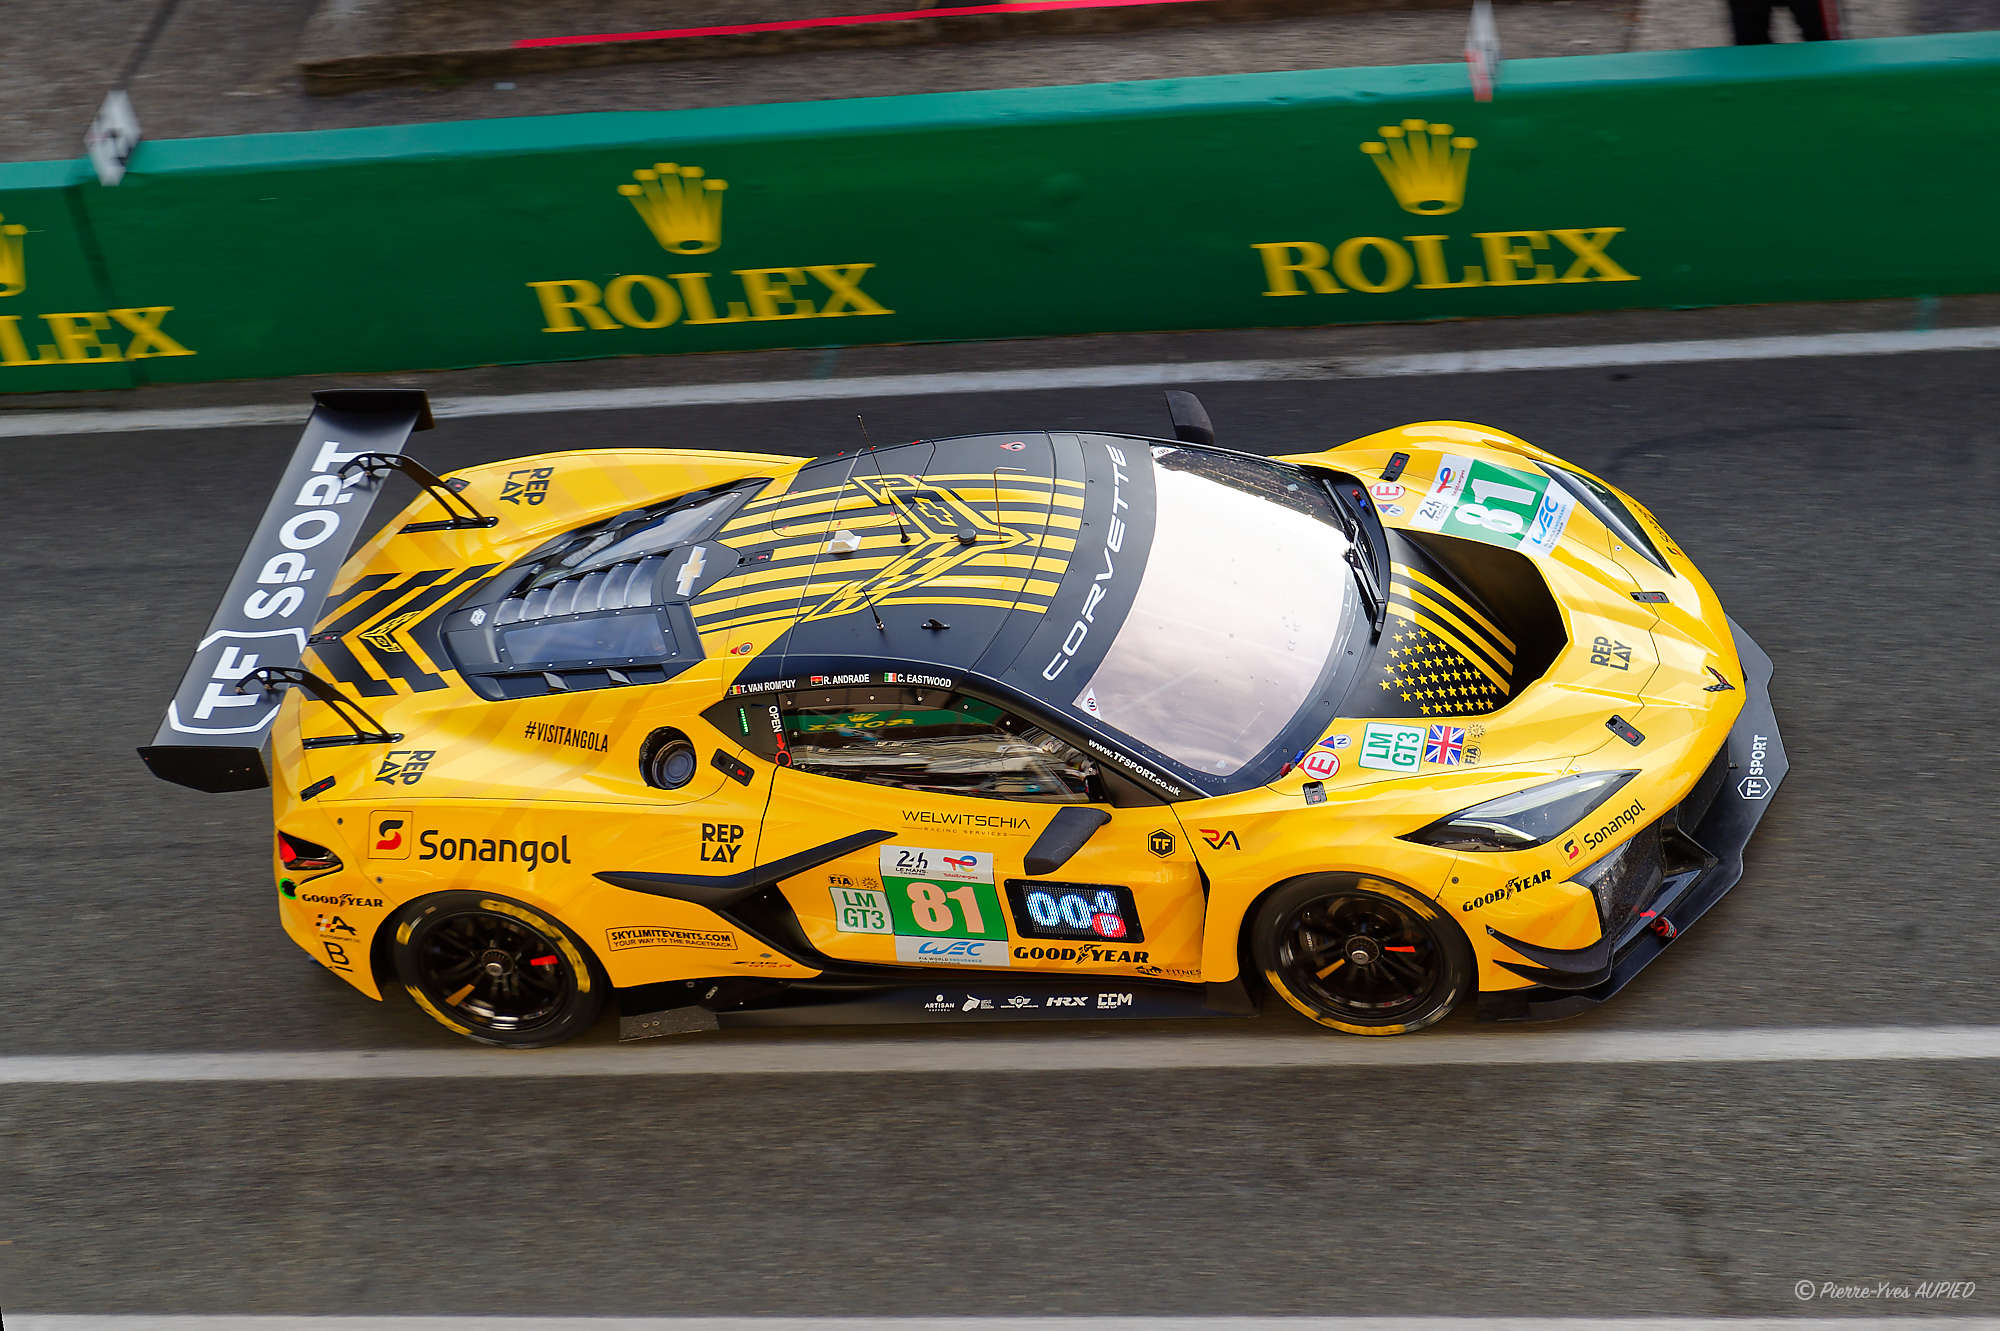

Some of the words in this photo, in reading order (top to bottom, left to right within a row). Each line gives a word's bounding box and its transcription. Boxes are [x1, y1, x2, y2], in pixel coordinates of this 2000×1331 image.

[1250, 227, 1641, 297] ROLEX
[526, 263, 895, 333] ROLEX
[499, 469, 530, 505] LAY
[524, 467, 554, 506] REP
[1376, 486, 1400, 496] E
[1455, 478, 1537, 534] 81
[1042, 444, 1129, 681] CORVETTE
[193, 646, 268, 719] TF
[244, 441, 397, 620] SPORT
[1590, 636, 1612, 666] REP
[1610, 640, 1632, 671] LAY
[741, 684, 747, 694] T.
[748, 682, 764, 692] VAN
[764, 679, 796, 691] ROMPUY
[823, 676, 831, 685] R.
[833, 673, 870, 685] ANDRADE
[897, 673, 905, 683] C.
[906, 674, 952, 688] EASTWOOD
[768, 705, 783, 733] OPEN
[525, 721, 608, 753] #VISITANGOLA
[1366, 732, 1393, 759] LM
[1392, 732, 1420, 766] GT3
[375, 751, 412, 785] LAY
[400, 751, 437, 785] REP
[1088, 739, 1180, 797] www.TFSPORT.co.uk
[1307, 756, 1335, 775] E
[1749, 734, 1768, 776] SPORT
[1746, 779, 1762, 796] TF
[701, 823, 744, 843] REP
[902, 810, 1030, 829] WELWITSCHIA
[963, 829, 1008, 837] SERVICES
[1584, 798, 1646, 850] Sonangol
[419, 830, 571, 872] Sonangol
[700, 843, 742, 863] LAY
[1153, 838, 1171, 850] TF
[829, 876, 851, 885] FIA
[842, 891, 877, 908] LM
[906, 881, 985, 933] 81
[844, 907, 885, 930] GT3
[611, 929, 731, 942] SKYLIMITEVENTS.COM
[613, 939, 636, 948] YOUR
[685, 939, 732, 948] RACETRACK
[918, 941, 985, 957] WEC
[1046, 996, 1089, 1007] HRX
[1097, 993, 1133, 1006] CCM
